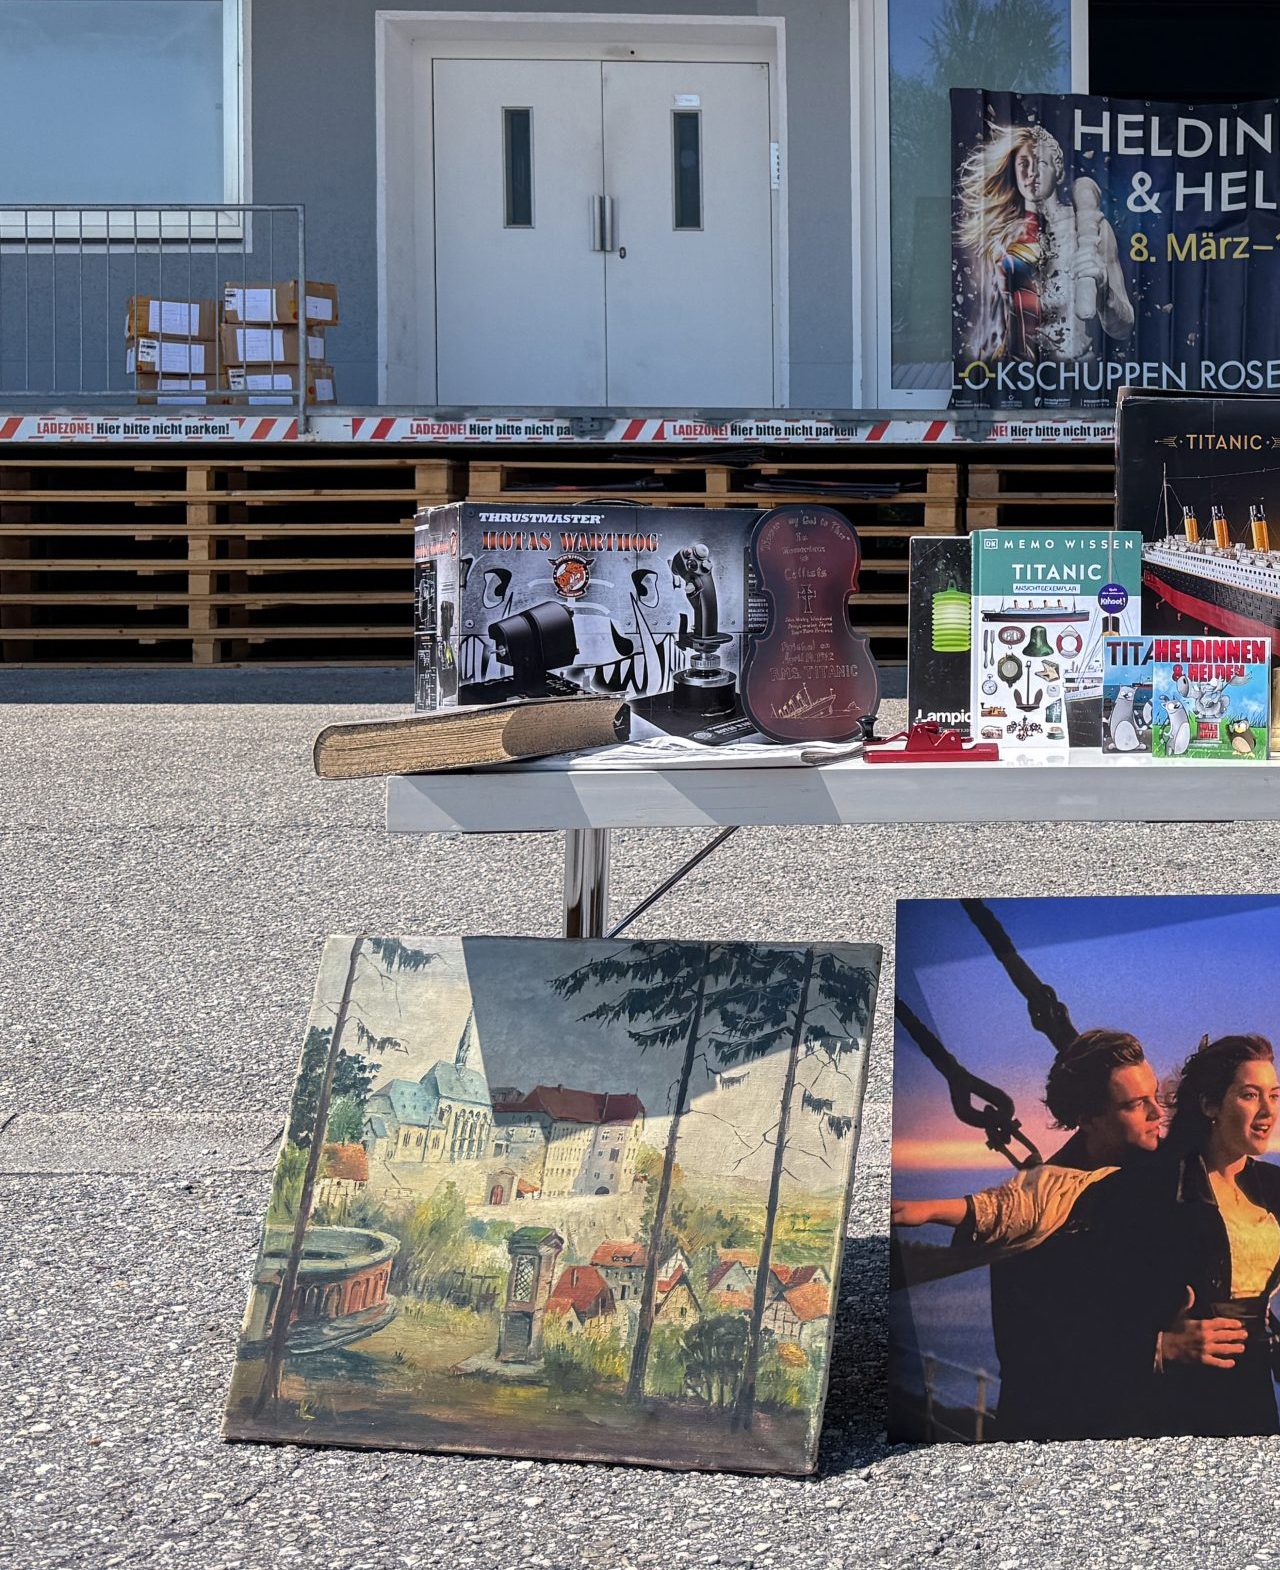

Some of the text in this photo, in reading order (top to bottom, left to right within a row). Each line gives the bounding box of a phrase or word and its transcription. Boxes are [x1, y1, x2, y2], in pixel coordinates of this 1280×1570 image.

[1126, 171, 1162, 214] &
[1130, 233, 1156, 262] 8.
[951, 360, 1186, 391] LOKSCHUPPEN
[37, 423, 229, 436] LADEZONE! Hier bitte nicht parken!
[410, 424, 466, 435] LADEZONE!
[469, 424, 493, 435] Hier
[496, 424, 522, 435] bitte
[525, 424, 555, 435] nicht
[673, 424, 728, 436] LADEZONE!
[730, 424, 753, 436] Hier
[756, 424, 781, 436] bitte
[784, 424, 813, 436] nicht
[1011, 425, 1033, 437] Hier
[1035, 425, 1061, 437] bitte
[1063, 425, 1090, 437] nicht
[1186, 434, 1262, 451] TITANIC
[479, 513, 603, 524] THRUSTMASTER
[482, 531, 659, 552] HOTAS WARTHOG
[985, 540, 1133, 549] DK MEMO WISSEN
[1012, 564, 1102, 580] TITANIC
[1154, 639, 1266, 664] HELDINNEN
